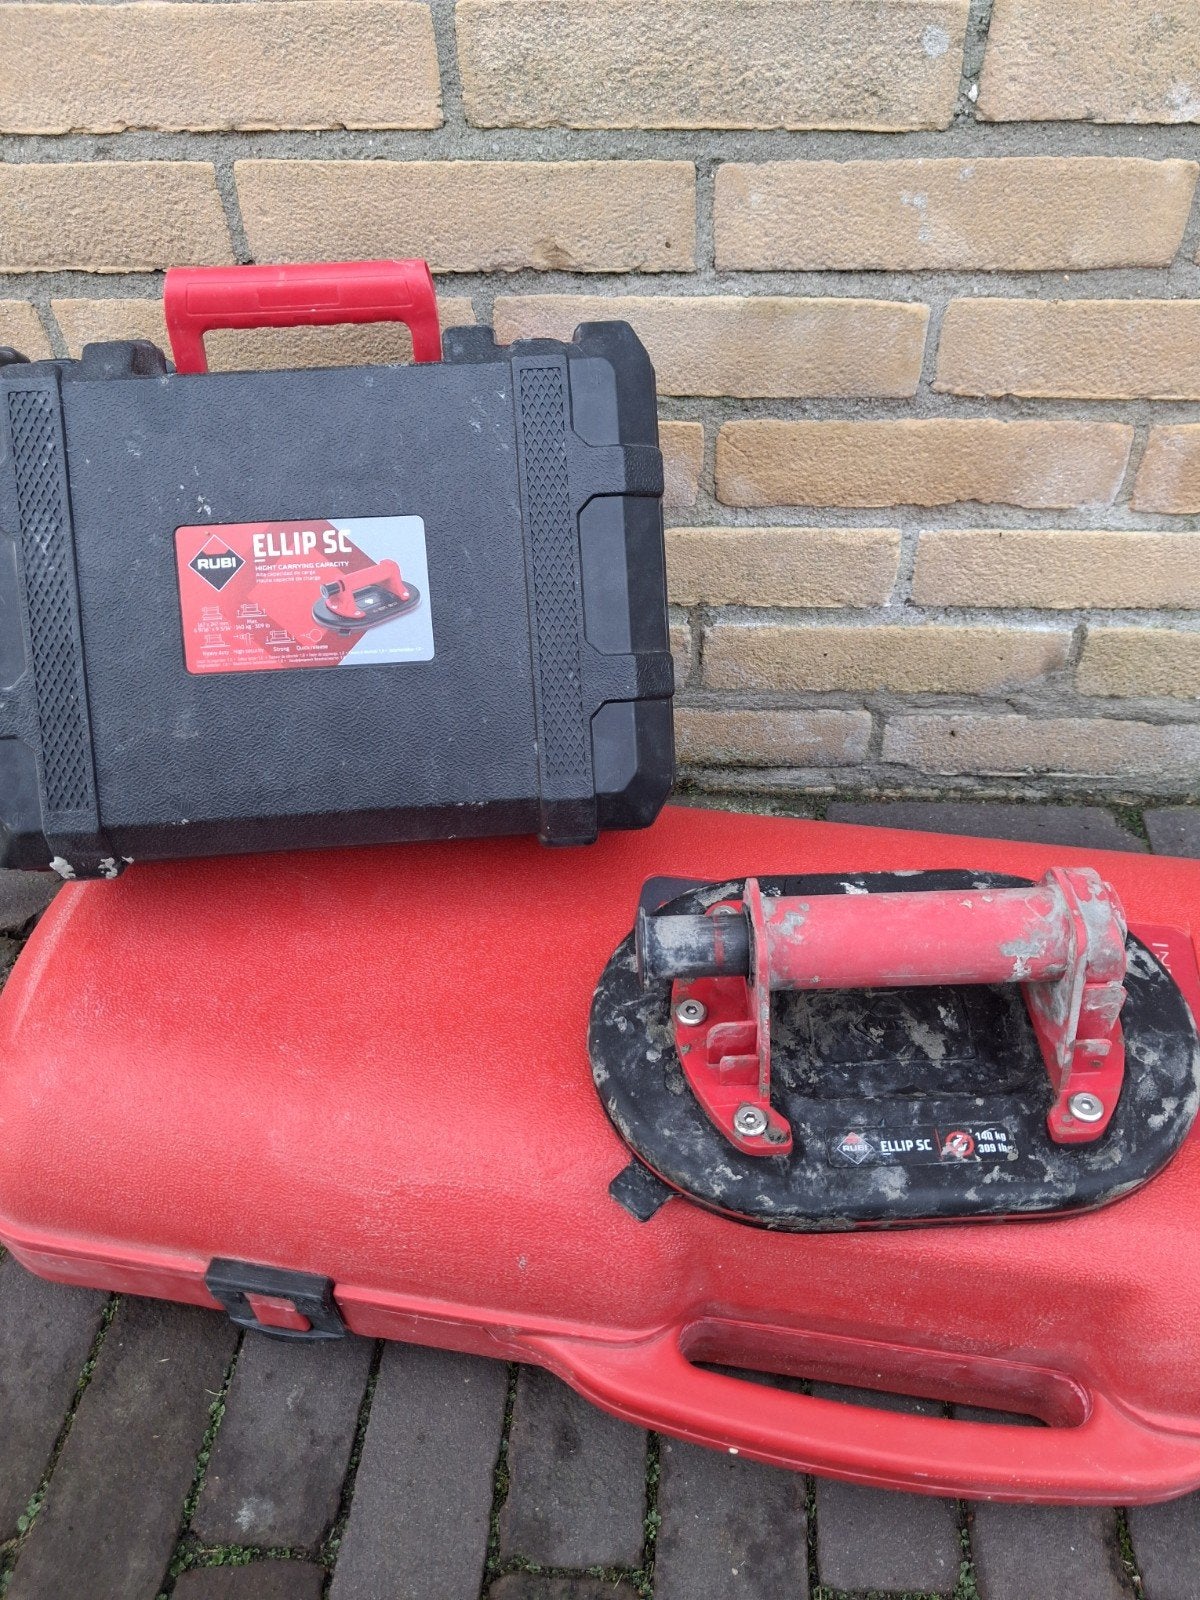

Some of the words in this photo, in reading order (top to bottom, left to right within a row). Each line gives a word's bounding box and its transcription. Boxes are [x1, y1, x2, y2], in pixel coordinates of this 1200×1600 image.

[252, 530, 317, 558] ELLIP
[322, 529, 353, 554] SC
[197, 556, 237, 570] RUBI
[278, 562, 315, 570] CARRYING
[315, 560, 350, 569] CAPACITY
[974, 1131, 993, 1141] 140
[994, 1131, 1007, 1142] kg
[842, 1144, 868, 1152] RUBI
[880, 1139, 913, 1153] ELLIP
[915, 1138, 933, 1151] SC
[977, 1143, 996, 1153] 309
